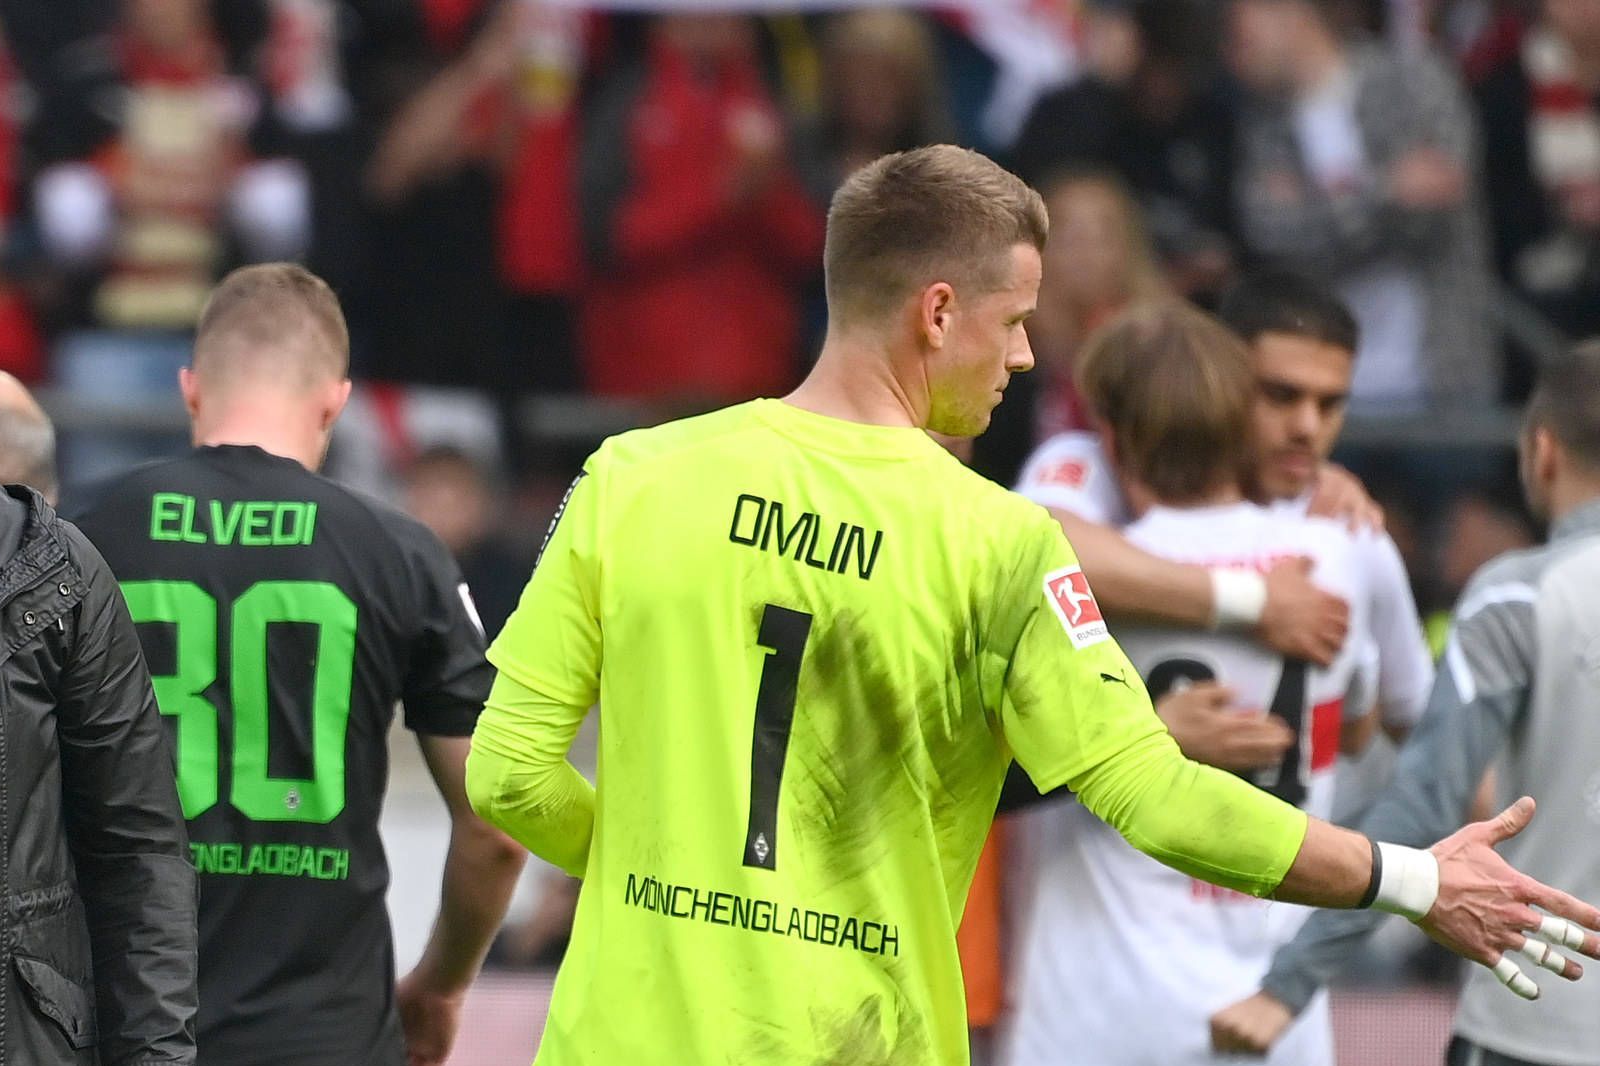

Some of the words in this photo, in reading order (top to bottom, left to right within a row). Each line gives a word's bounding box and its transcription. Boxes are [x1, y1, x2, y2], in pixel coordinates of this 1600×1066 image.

[150, 492, 319, 546] ELVEDI
[729, 493, 883, 581] OMLIN
[741, 603, 813, 872] 1
[624, 872, 900, 957] MÖNCHENGLADBACH
